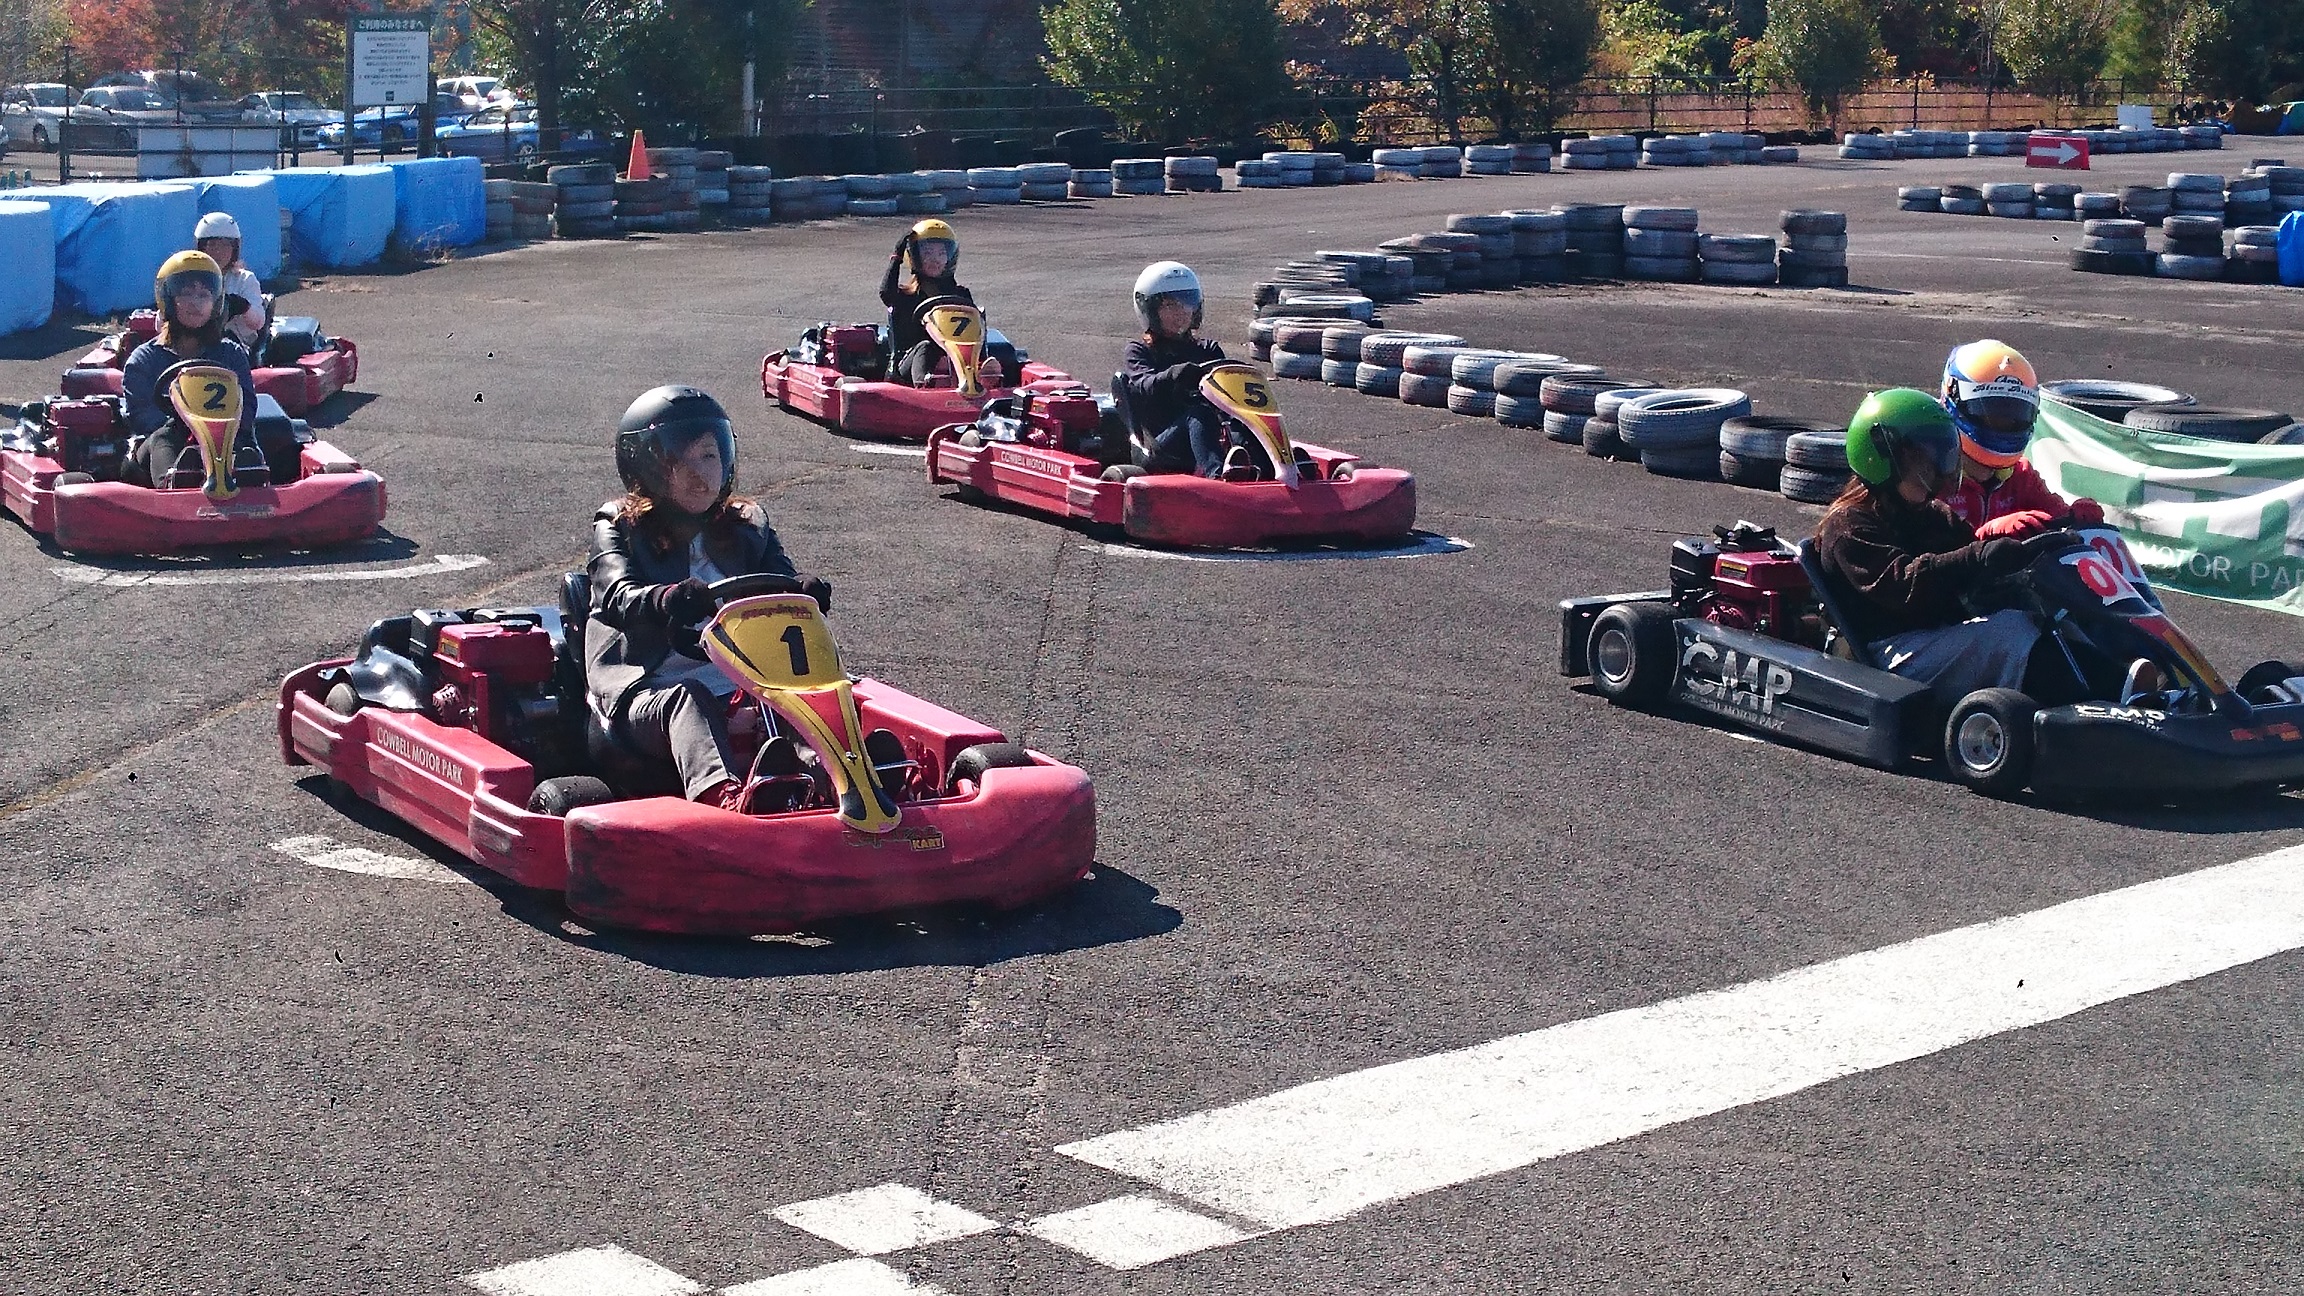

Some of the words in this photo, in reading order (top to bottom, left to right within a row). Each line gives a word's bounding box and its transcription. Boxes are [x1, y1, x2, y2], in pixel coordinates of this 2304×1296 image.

[951, 316, 971, 337] 7
[203, 382, 227, 410] 2
[1244, 382, 1268, 407] 5
[1047, 463, 1062, 475] PARK
[780, 625, 810, 675] 1
[1682, 633, 1793, 714] CMP
[2074, 704, 2165, 724] CMP
[377, 727, 411, 759] COWBELL
[412, 744, 441, 774] MOTOR
[442, 759, 463, 786] PARK
[912, 837, 942, 849] KART
